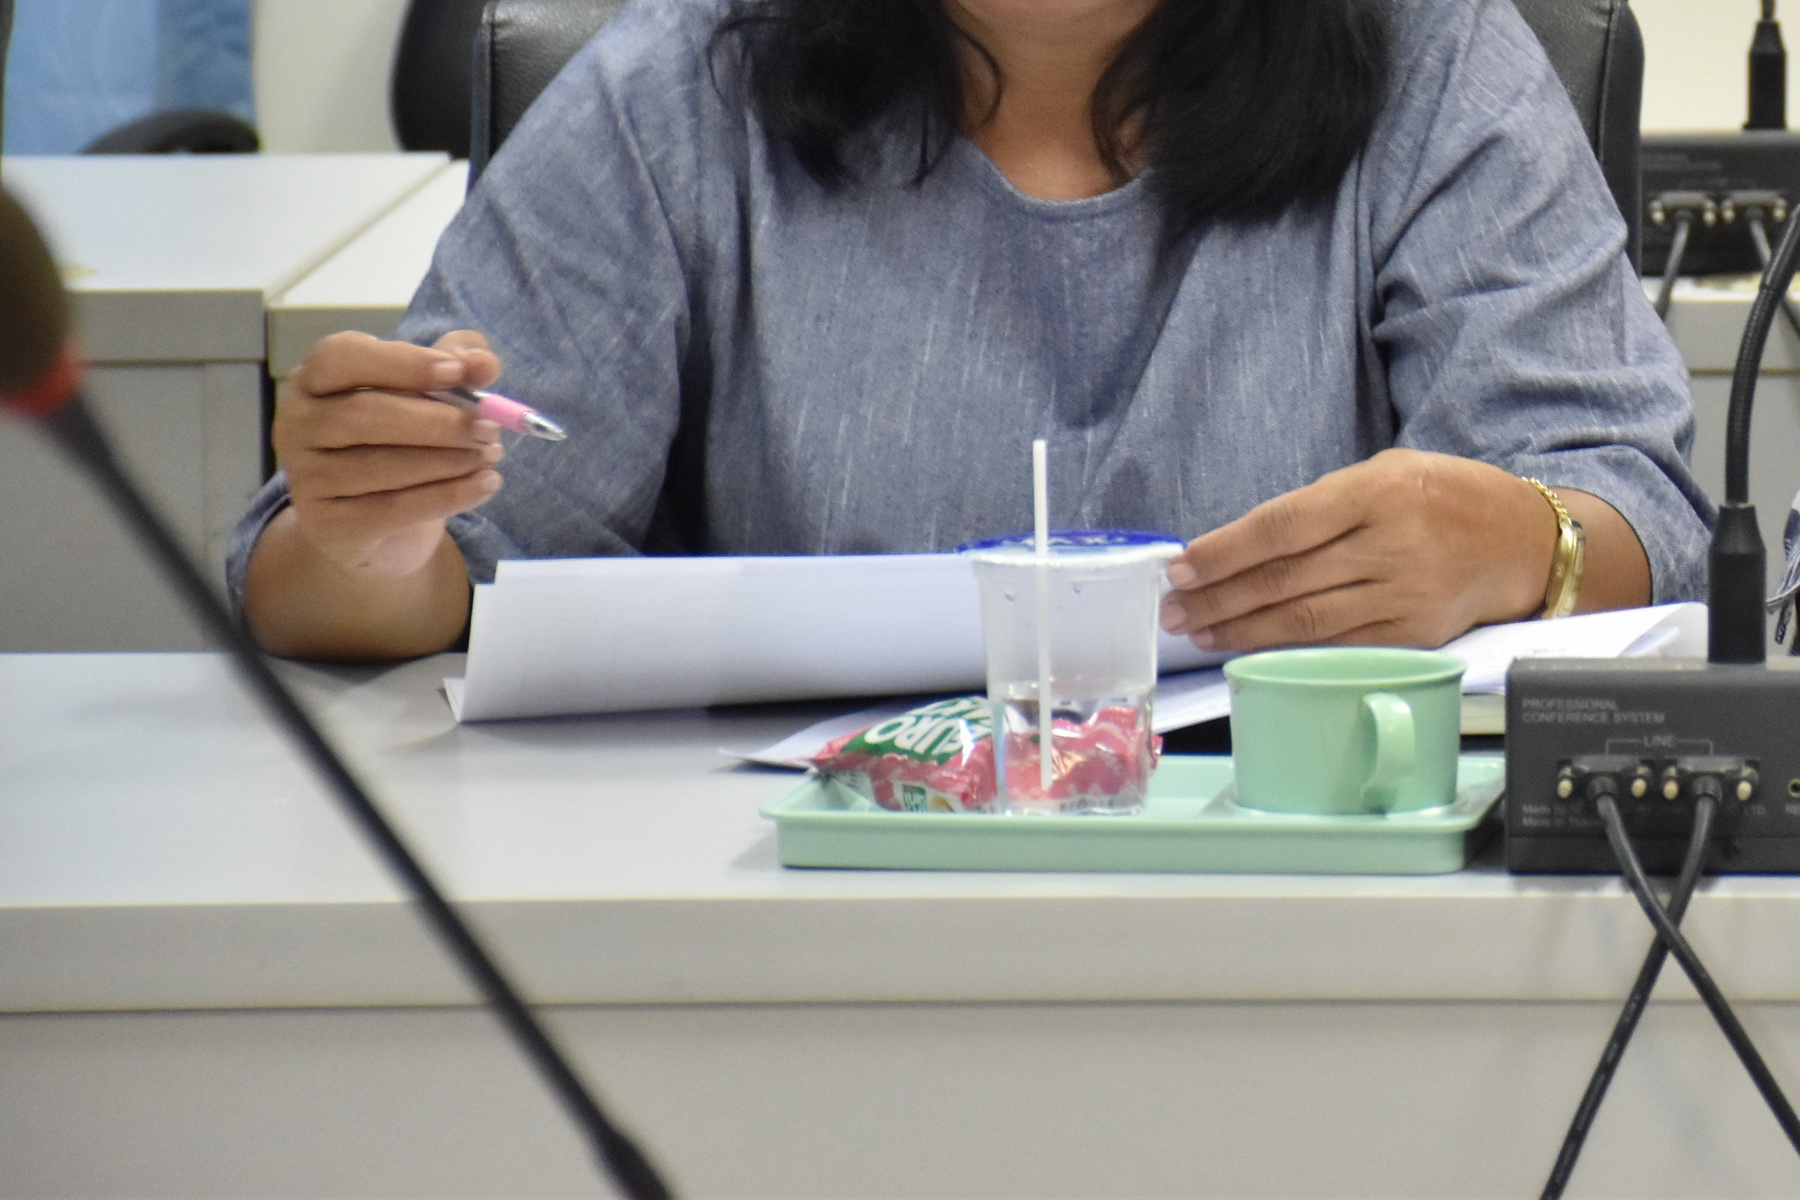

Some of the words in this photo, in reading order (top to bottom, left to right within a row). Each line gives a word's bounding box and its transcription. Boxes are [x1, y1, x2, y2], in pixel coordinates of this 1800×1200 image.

[1521, 711, 1610, 724] CONFERENCE
[1613, 711, 1666, 724] SYSTEM
[1643, 733, 1677, 748] LINE
